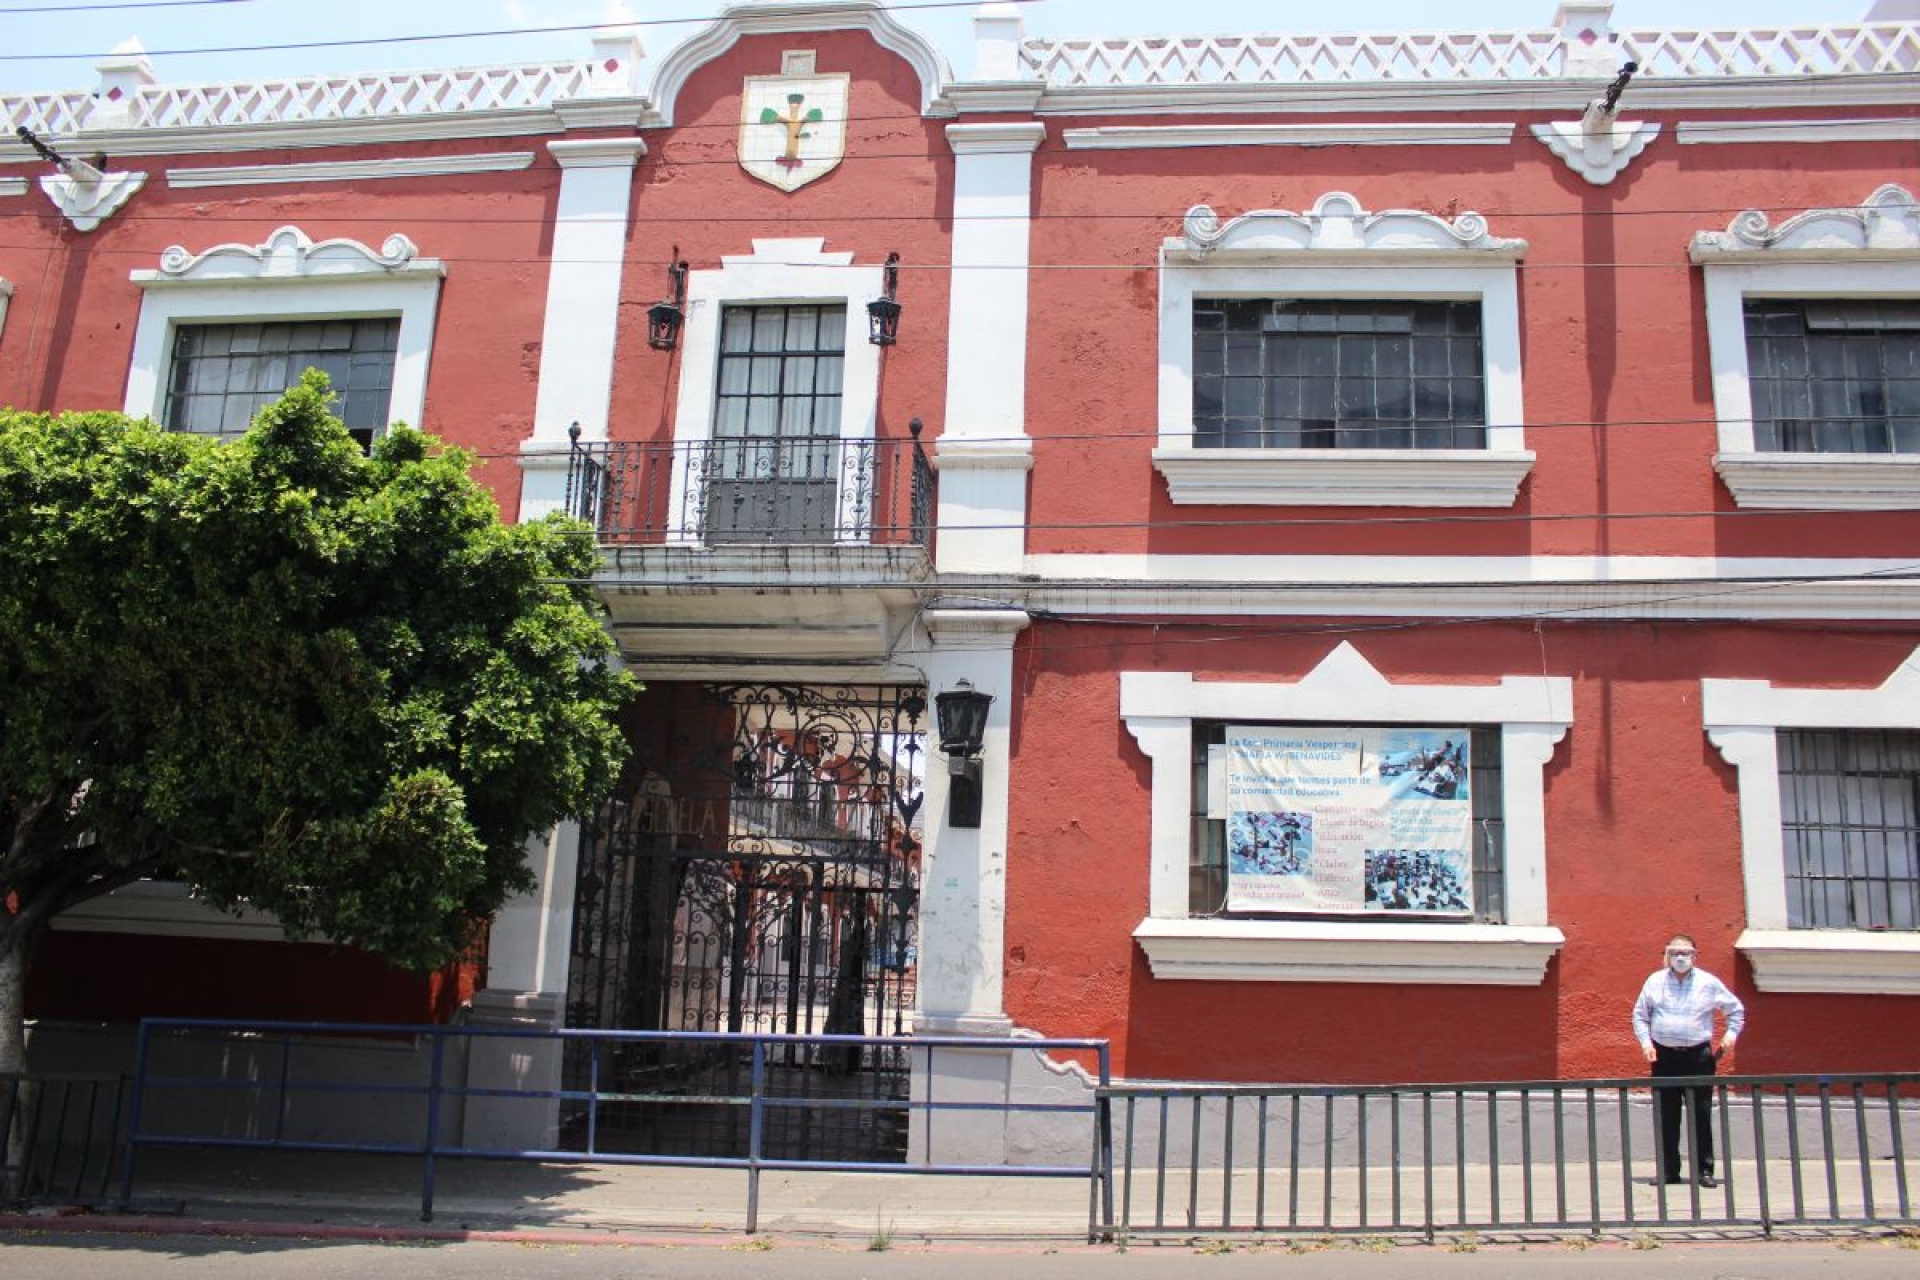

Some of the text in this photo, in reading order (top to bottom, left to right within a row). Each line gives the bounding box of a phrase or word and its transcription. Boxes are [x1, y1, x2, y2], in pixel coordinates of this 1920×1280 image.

[1229, 738, 1240, 748] La
[1264, 739, 1303, 748] Primaria
[1229, 774, 1241, 783] Te
[1279, 777, 1294, 786] que
[1333, 776, 1357, 786] parte
[1360, 776, 1372, 785] de
[1229, 787, 1241, 795] su
